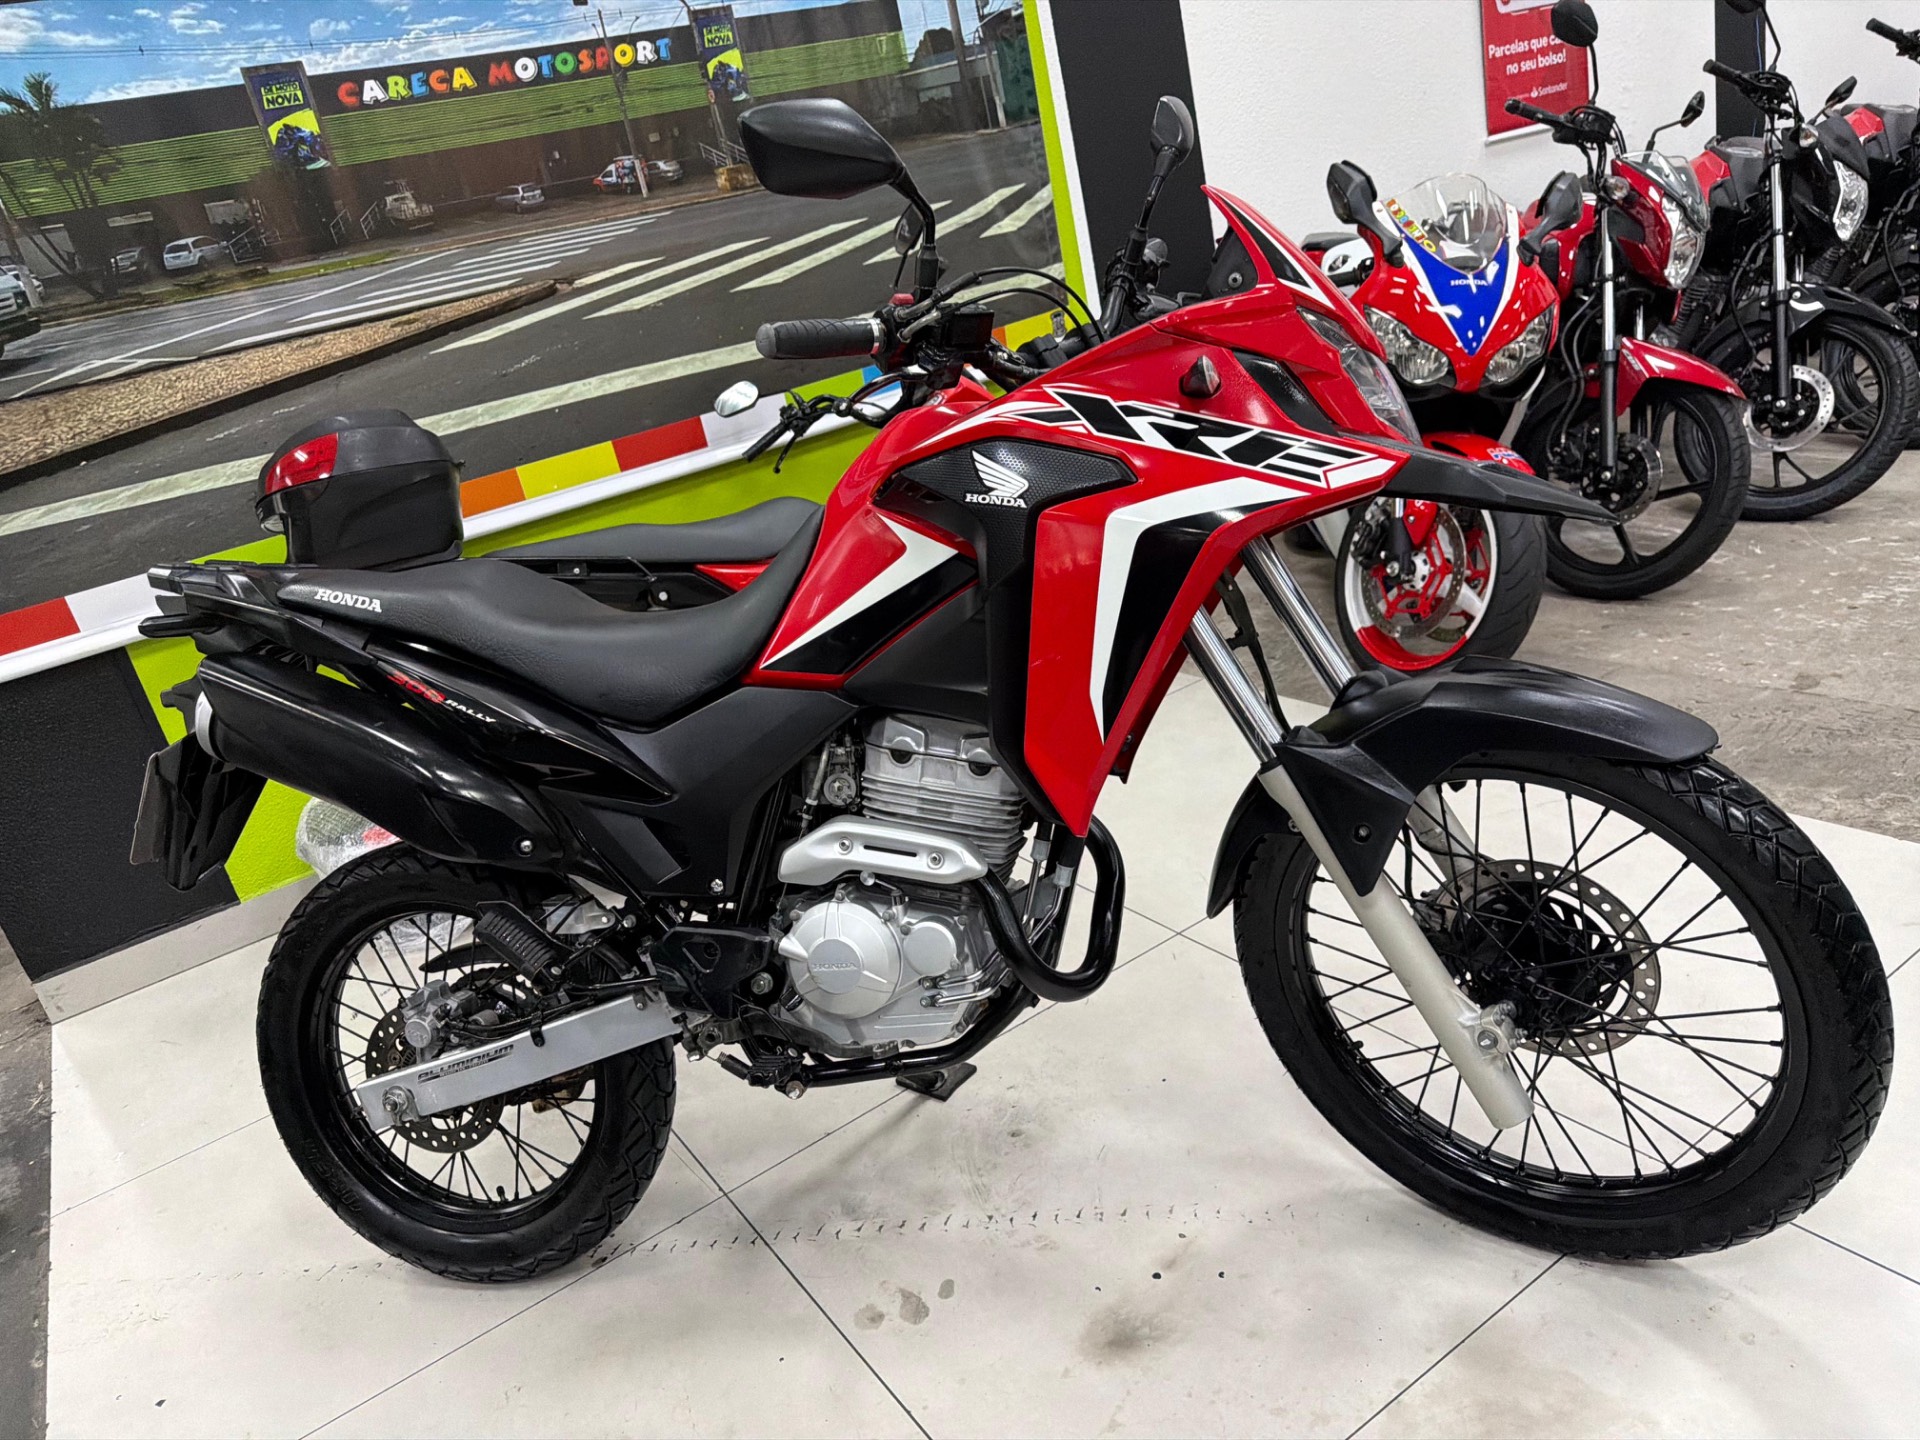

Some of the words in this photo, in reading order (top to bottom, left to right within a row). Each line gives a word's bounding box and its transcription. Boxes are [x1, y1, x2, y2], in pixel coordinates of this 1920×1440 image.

[1488, 38, 1530, 59] Parcelas
[1530, 35, 1548, 53] que
[337, 66, 477, 106] CARECA
[488, 37, 672, 86] MOTOSPORT
[1506, 62, 1519, 76] no
[1520, 57, 1537, 72] seu
[1537, 48, 1567, 68] bolso!
[1538, 82, 1568, 97] Santander
[265, 92, 302, 108] NOVA
[1450, 279, 1488, 287] HONDA
[964, 493, 1028, 509] HONDA
[314, 588, 382, 613] HONDA
[444, 699, 497, 723] RALLY
[811, 963, 858, 972] HONDA
